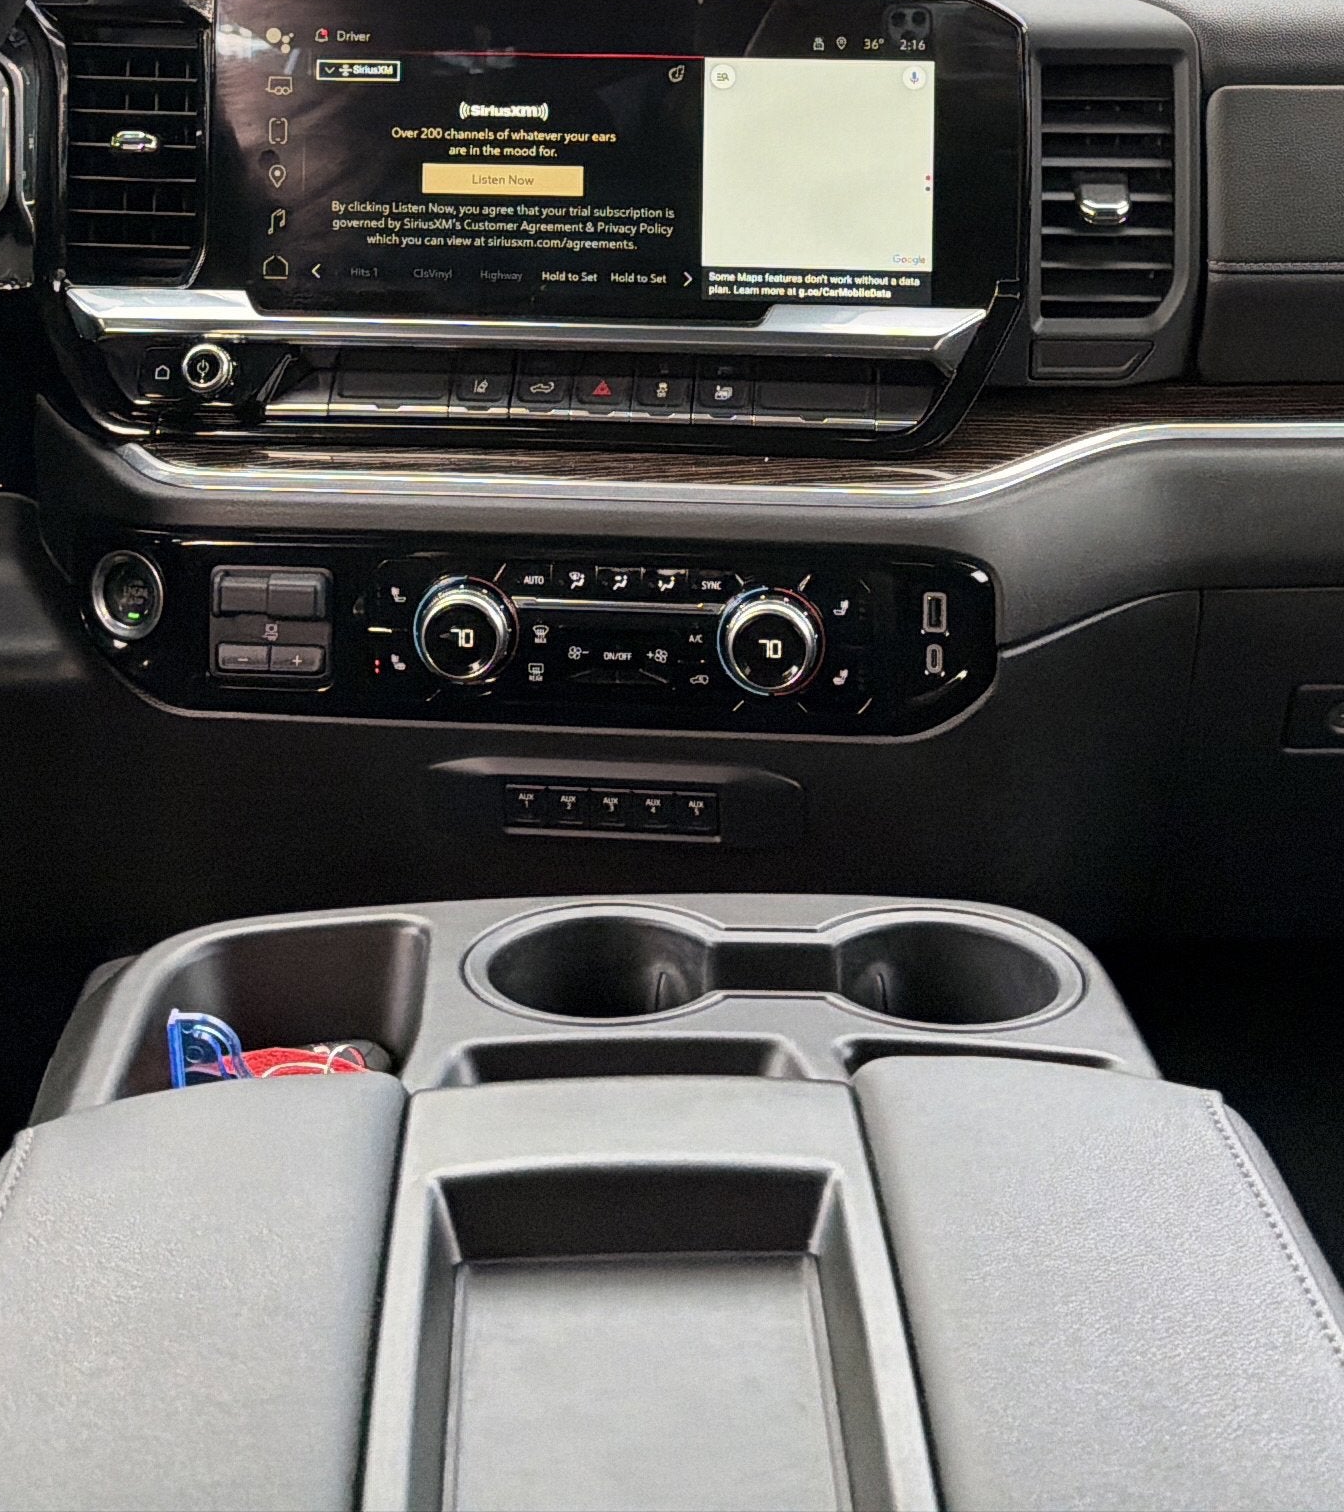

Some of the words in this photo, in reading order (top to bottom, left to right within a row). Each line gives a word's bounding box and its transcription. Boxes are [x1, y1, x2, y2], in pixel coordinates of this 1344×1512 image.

[337, 30, 371, 42] Driver
[863, 38, 884, 50] 36°
[900, 39, 926, 50] 2:16
[352, 64, 393, 75] SiriusXM
[391, 127, 417, 139] Over
[421, 128, 442, 139] 200
[444, 128, 495, 140] channels
[497, 129, 509, 140] of
[511, 130, 563, 142] whatever
[564, 132, 590, 144] your
[592, 133, 616, 142] ears
[449, 147, 466, 155] are
[469, 145, 480, 155] in
[482, 145, 500, 156] the
[503, 145, 536, 157] mood
[539, 146, 558, 157] for.
[472, 174, 505, 185] Listen
[508, 175, 534, 186] Now
[332, 200, 345, 214] By
[348, 201, 389, 216] clicking
[392, 202, 425, 214] Listen
[428, 203, 456, 215] Now,
[458, 206, 480, 217] you
[482, 206, 513, 218] agree
[517, 205, 539, 216] that
[541, 207, 566, 218] your
[569, 205, 590, 217] trial
[594, 206, 663, 220] subscription
[666, 208, 674, 218] is
[332, 217, 384, 231] governed
[387, 218, 401, 231] by
[404, 218, 461, 230] SiriusXM's
[464, 219, 518, 231] Customer
[520, 220, 583, 234] Agreement
[585, 221, 595, 233] &
[597, 222, 636, 236] Privacy
[639, 223, 673, 237] Policy
[367, 233, 399, 245] which
[401, 237, 422, 247] you
[424, 237, 444, 246] can
[447, 236, 472, 246] view
[474, 236, 485, 246] at
[487, 236, 637, 251] siriusxm.com/agreements.
[893, 254, 926, 266] Google
[351, 267, 371, 278] Hits
[480, 270, 522, 283] Highway
[541, 271, 565, 282] Hold
[567, 272, 578, 282] to
[580, 272, 598, 283] Set
[610, 272, 634, 283] Hold
[637, 273, 648, 283] to
[650, 273, 667, 284] Set
[709, 271, 735, 282] Some
[737, 272, 763, 284] Maps
[765, 273, 803, 284] features
[805, 273, 828, 284] don't
[830, 274, 852, 285] work
[854, 274, 889, 286] without
[891, 277, 897, 286] a
[899, 276, 920, 287] data
[709, 285, 731, 296] plan.
[733, 285, 759, 295] Learn
[761, 287, 785, 296] more
[787, 287, 796, 296] at
[798, 286, 892, 299] g.co/CarMobileData
[523, 575, 545, 585] AUTO
[701, 581, 722, 591] SYNC
[450, 628, 474, 648] 70
[688, 634, 703, 644] A/C
[758, 639, 782, 659] 70
[603, 651, 632, 661] ON/OFF
[518, 793, 534, 801] AUX
[560, 795, 576, 803] AUX
[602, 797, 618, 805] AUX
[645, 799, 661, 807] AUX
